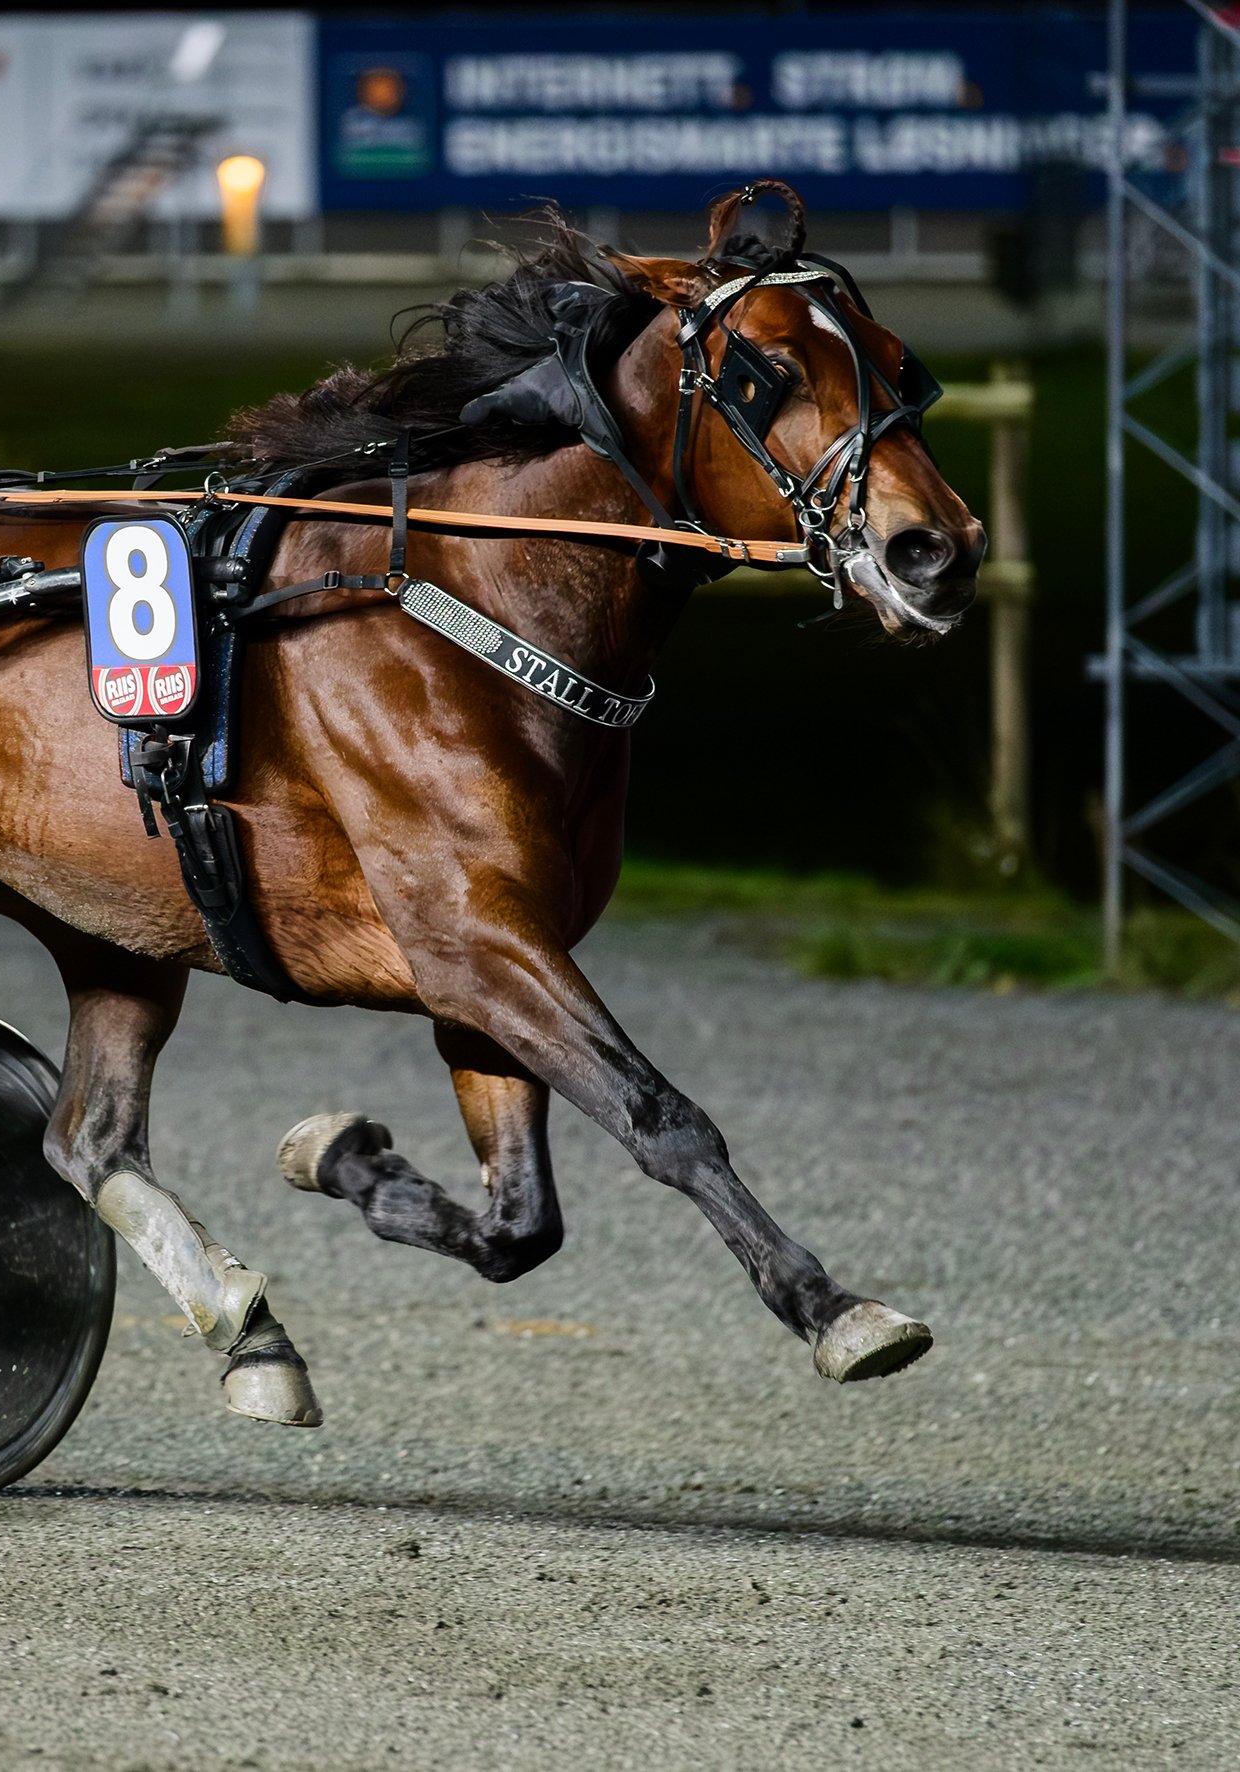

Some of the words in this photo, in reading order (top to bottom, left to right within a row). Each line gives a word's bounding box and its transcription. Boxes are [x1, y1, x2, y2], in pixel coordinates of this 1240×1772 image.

[105, 525, 177, 661] 8
[106, 674, 136, 700] RIIS
[155, 672, 185, 699] RIIS
[505, 647, 594, 714] STALL
